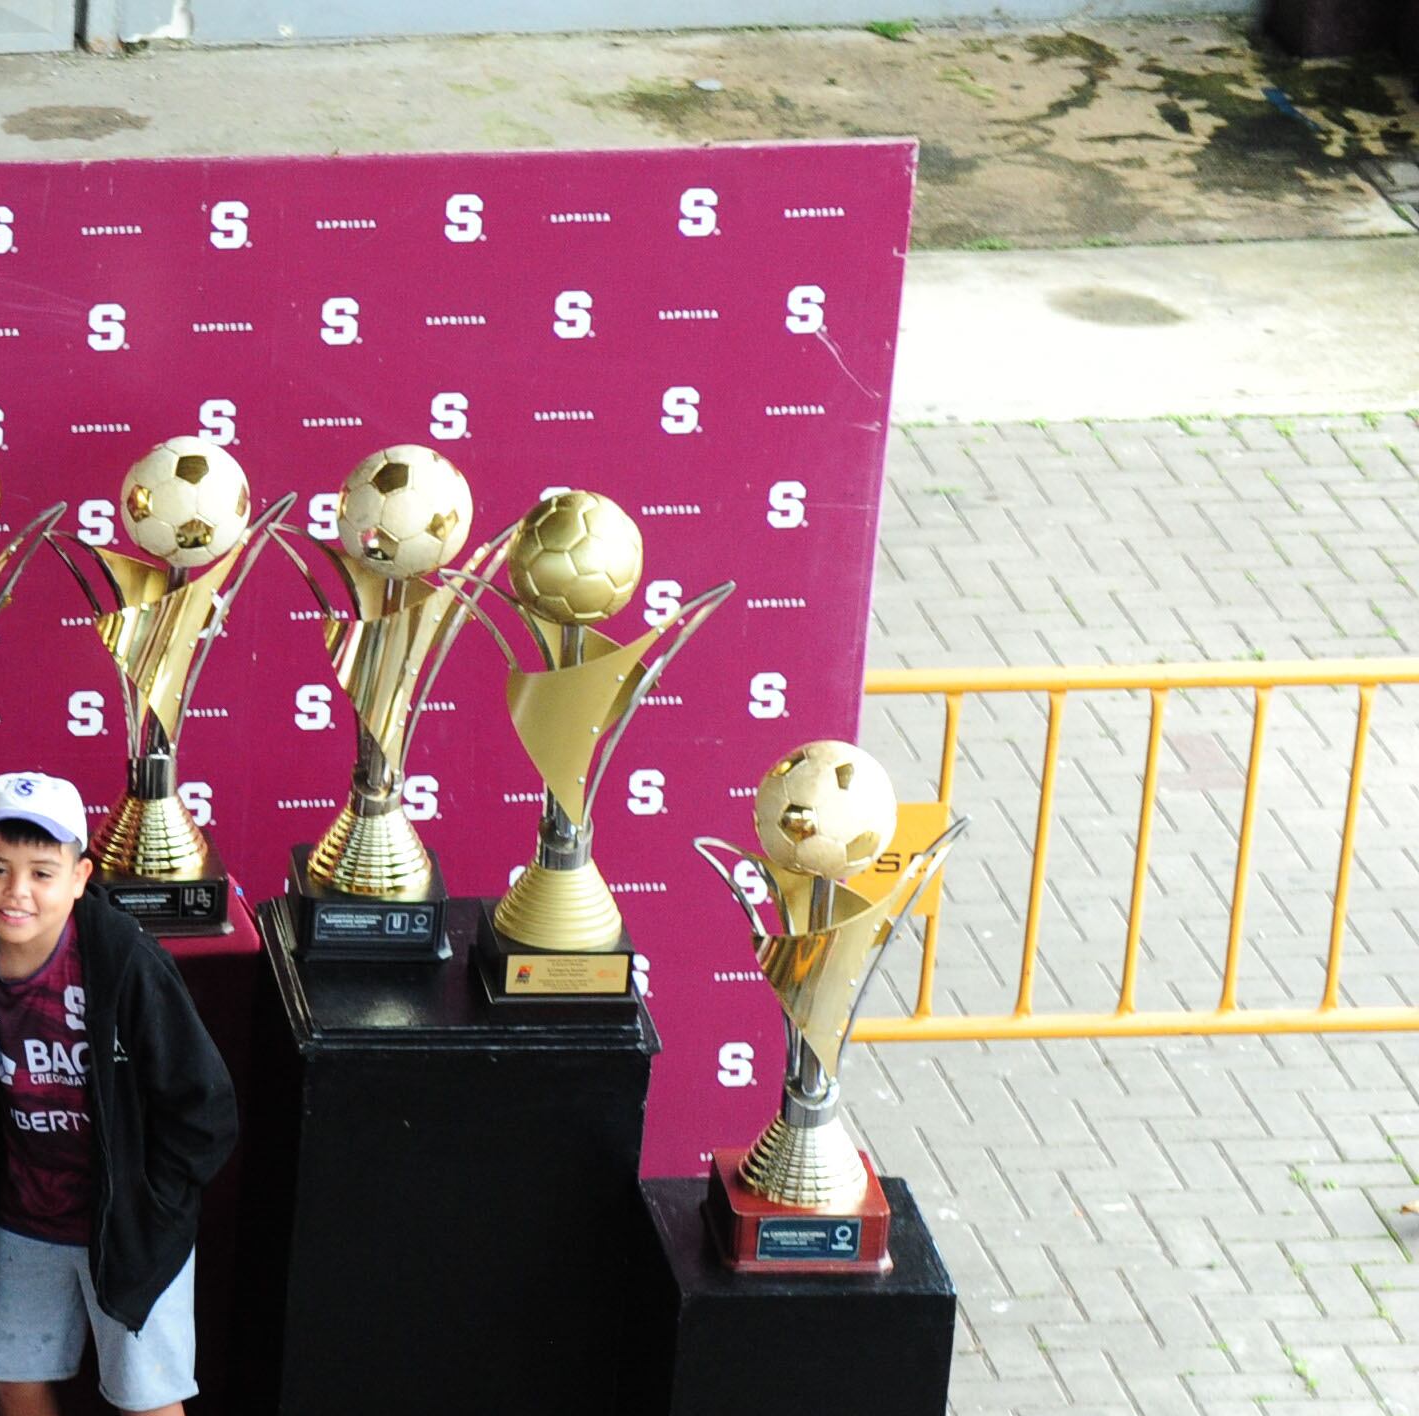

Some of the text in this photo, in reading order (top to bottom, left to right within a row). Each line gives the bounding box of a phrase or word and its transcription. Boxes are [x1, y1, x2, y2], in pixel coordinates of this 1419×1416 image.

[80, 224, 143, 236] SAPRISSA
[210, 201, 249, 249] S
[315, 219, 377, 230] SAPRISSA
[444, 194, 481, 242] S
[549, 212, 611, 224] SAPRISSA
[678, 188, 715, 237] S
[783, 206, 846, 219] SAPRISSA
[87, 303, 124, 351] S
[192, 321, 254, 333] SAPRISSA
[320, 297, 357, 345] S
[425, 314, 487, 326] SAPRISSA
[553, 290, 590, 339] S
[658, 308, 719, 321] SAPRISSA
[786, 286, 825, 334] S
[70, 423, 131, 434] SAPRISSA
[199, 400, 237, 445] S
[302, 416, 363, 428] SAPRISSA
[430, 392, 466, 440] S
[533, 410, 595, 422] SAPRISSA
[661, 386, 697, 434] S
[765, 404, 826, 417] SAPRISSA
[78, 500, 115, 546] S
[308, 494, 340, 540] S
[641, 504, 701, 516] SAPRISSA
[767, 481, 802, 529] S
[643, 580, 682, 626] S
[746, 597, 807, 609] SAPRISSA
[67, 691, 102, 736] S
[294, 684, 329, 730] S
[748, 672, 783, 719] S
[177, 781, 212, 827] S
[277, 798, 336, 810] SAPRISSA
[402, 775, 439, 820] S
[627, 769, 662, 815] S
[609, 882, 666, 892] SAPRISSA
[732, 860, 769, 904] S
[24, 1039, 91, 1075] BAC
[30, 1072, 88, 1087] CREDOMAT
[717, 1042, 751, 1087] S
